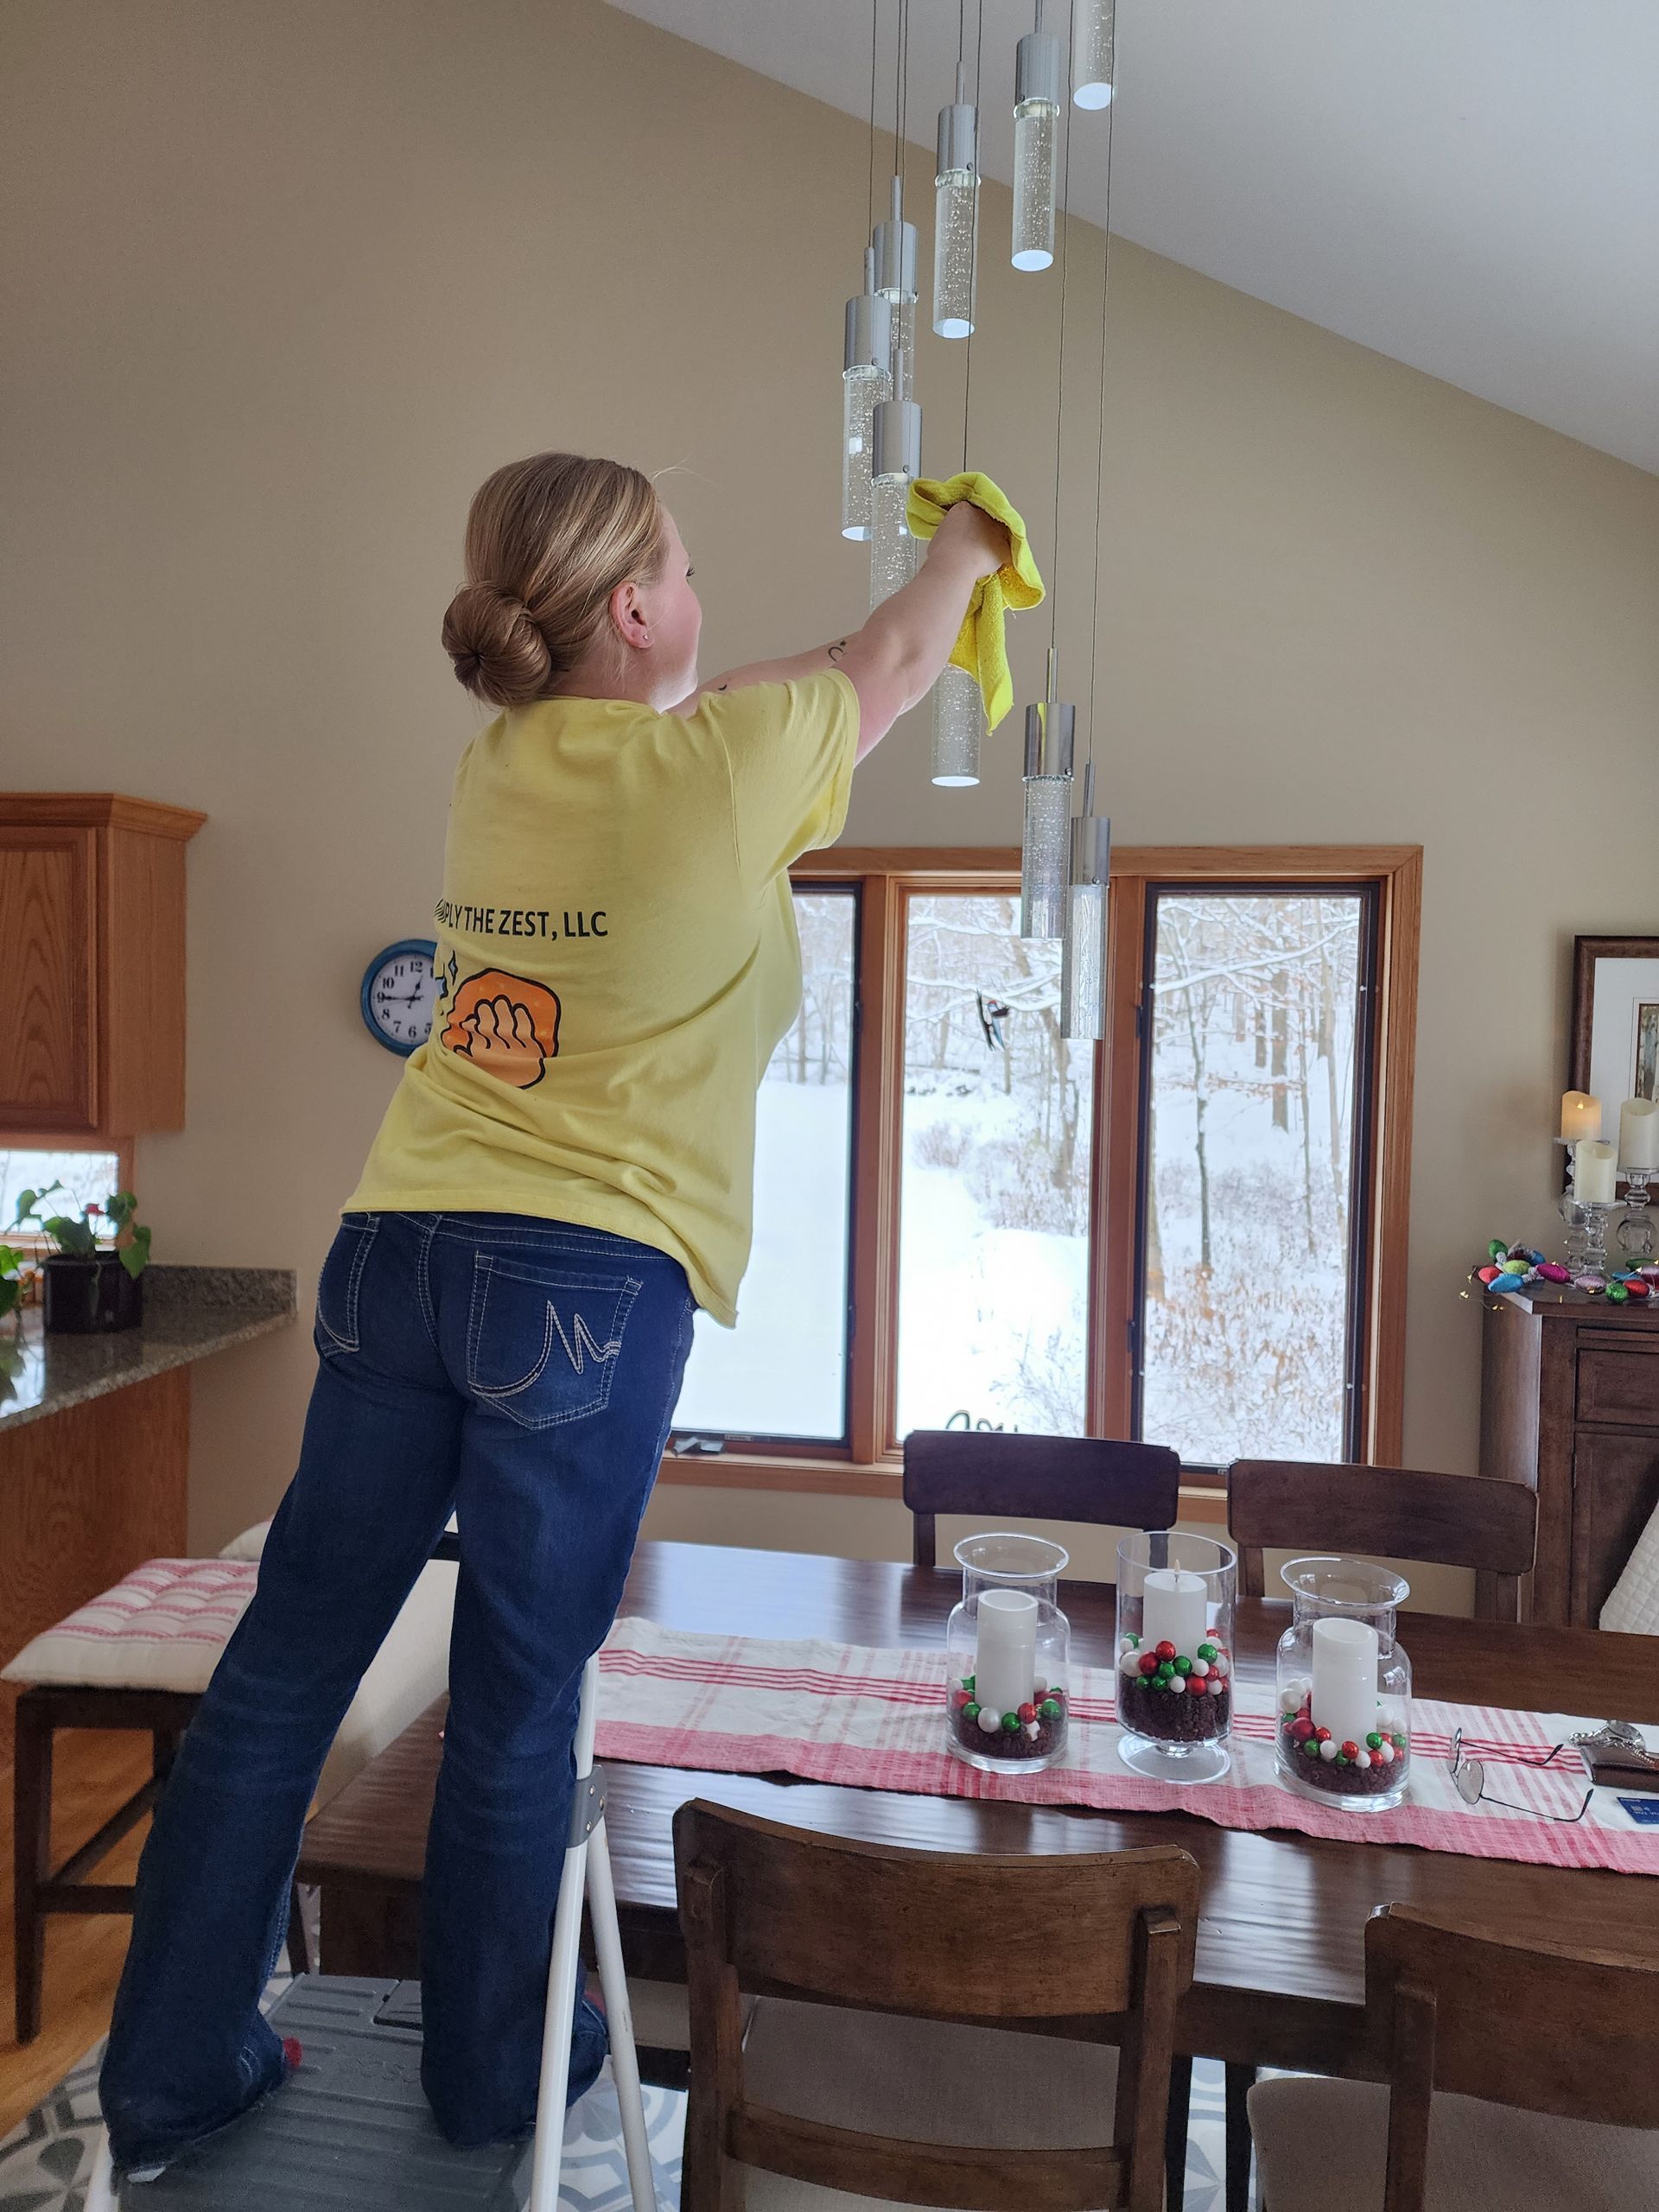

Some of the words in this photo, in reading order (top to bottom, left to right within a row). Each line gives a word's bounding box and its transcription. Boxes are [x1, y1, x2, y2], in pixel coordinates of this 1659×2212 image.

[435, 899, 462, 929] PLY
[464, 907, 495, 934] THE
[498, 910, 557, 941] ZEST,
[563, 912, 608, 937] LLC
[395, 965, 404, 977] 11
[410, 961, 423, 973] 12
[383, 977, 395, 989] 10
[377, 991, 385, 1003] 9
[381, 1008, 390, 1020] 8
[393, 1020, 402, 1033] 7
[408, 1026, 416, 1038] 6
